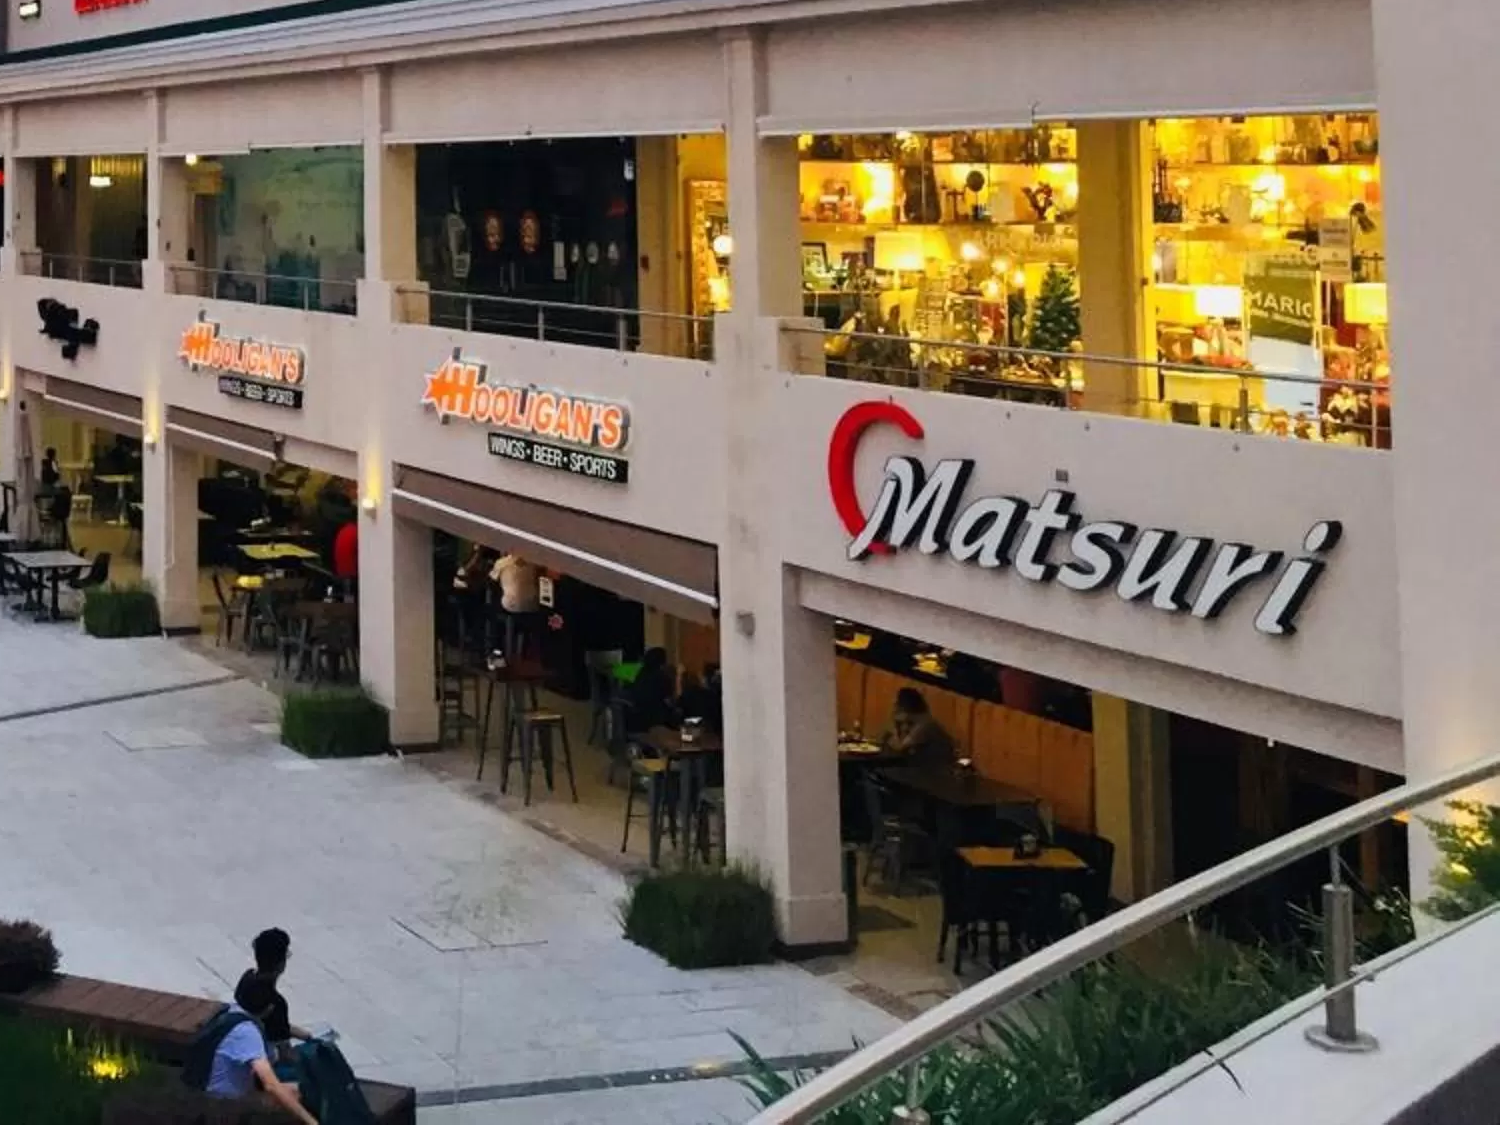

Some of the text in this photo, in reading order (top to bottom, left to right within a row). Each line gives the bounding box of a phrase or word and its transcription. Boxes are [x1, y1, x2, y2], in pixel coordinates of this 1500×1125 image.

[423, 358, 628, 449] HOOLIGAN'S
[490, 435, 618, 480] WINGS BEER SPORTS
[847, 456, 1342, 636] Matsuri
